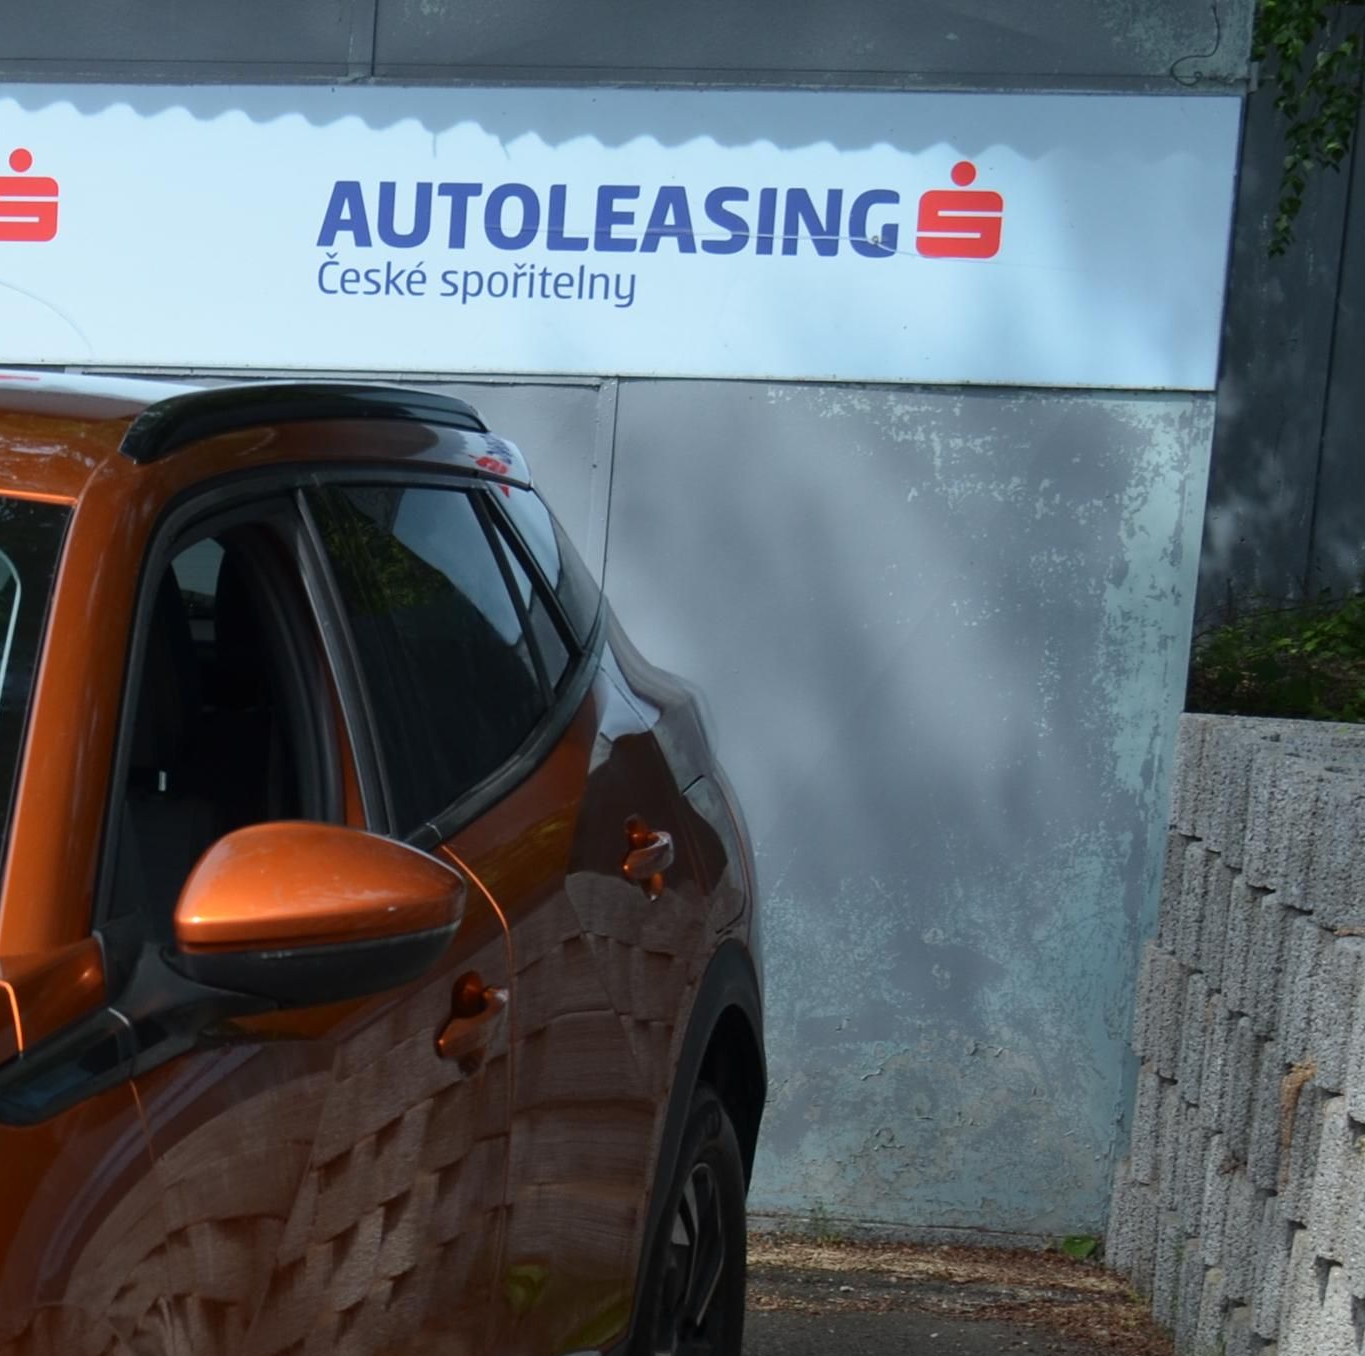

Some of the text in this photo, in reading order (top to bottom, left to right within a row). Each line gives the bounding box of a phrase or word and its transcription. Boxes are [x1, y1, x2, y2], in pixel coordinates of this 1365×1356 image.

[316, 180, 901, 259] AUTOLEASING
[317, 251, 637, 308] České spořitelny
